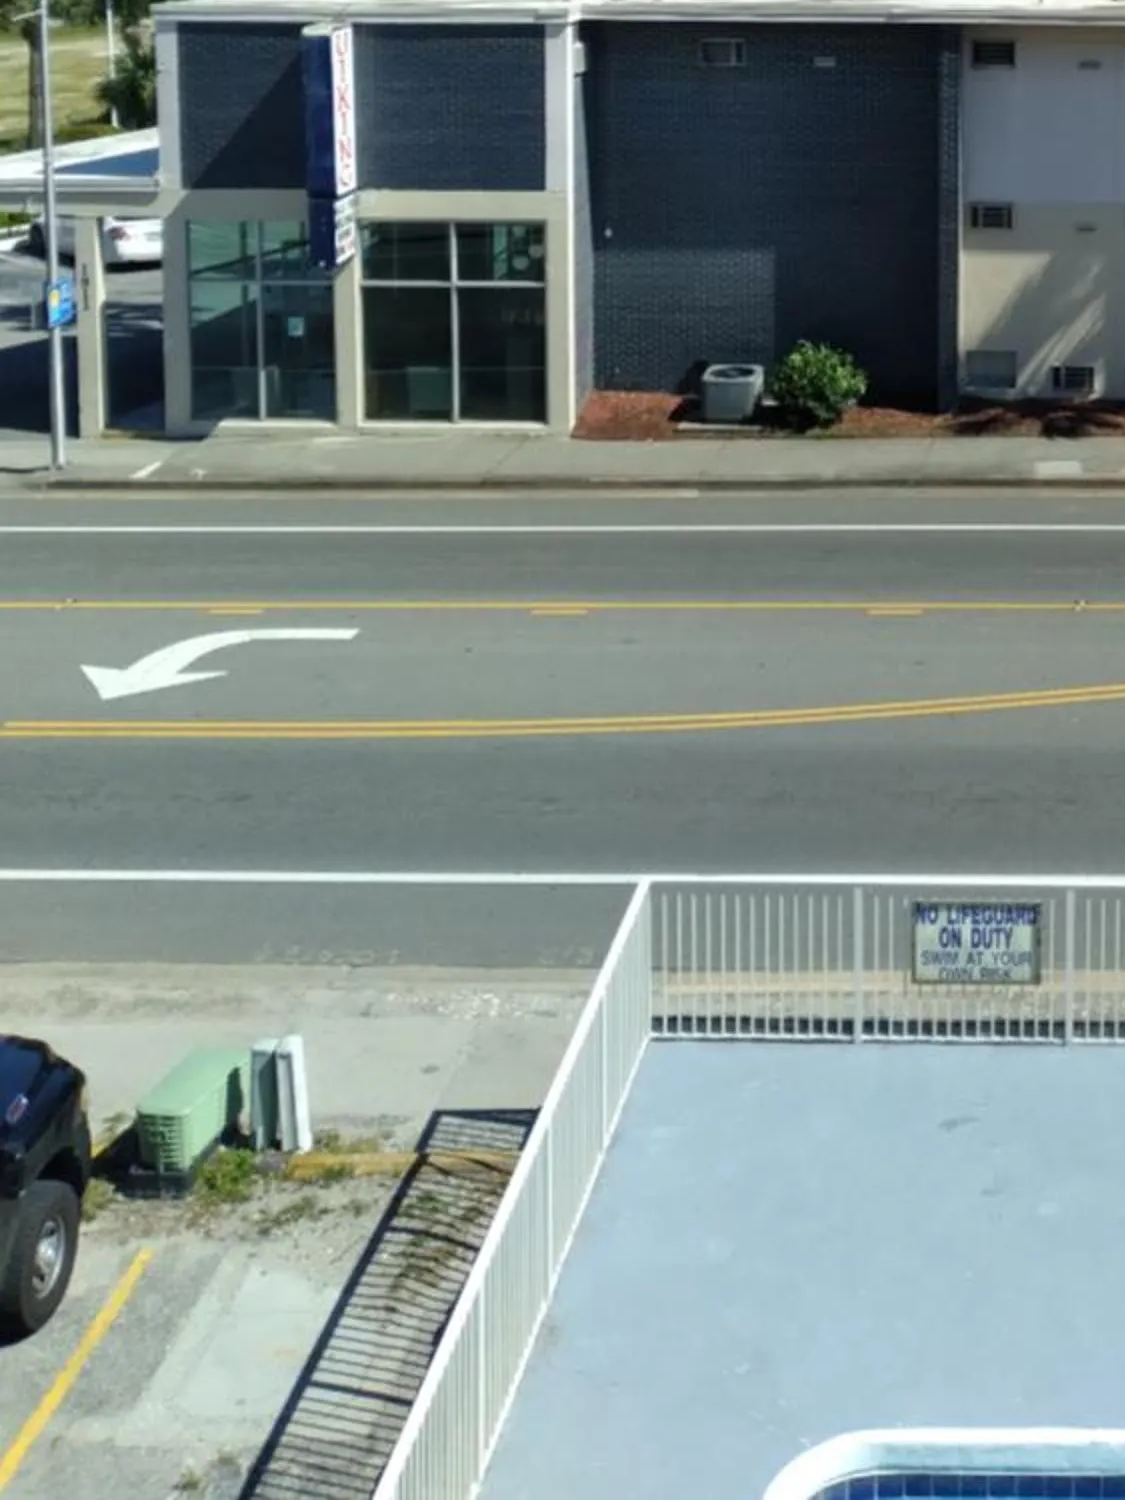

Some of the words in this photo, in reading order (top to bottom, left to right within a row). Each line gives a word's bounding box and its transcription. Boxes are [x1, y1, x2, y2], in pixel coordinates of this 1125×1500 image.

[917, 904, 938, 924] NO
[946, 903, 1037, 925] LIFEGUARD
[939, 926, 962, 949] ON
[971, 926, 1013, 949] DUTY
[920, 950, 959, 966] SWIM
[966, 951, 984, 965] AT
[991, 950, 1034, 967] YOUR
